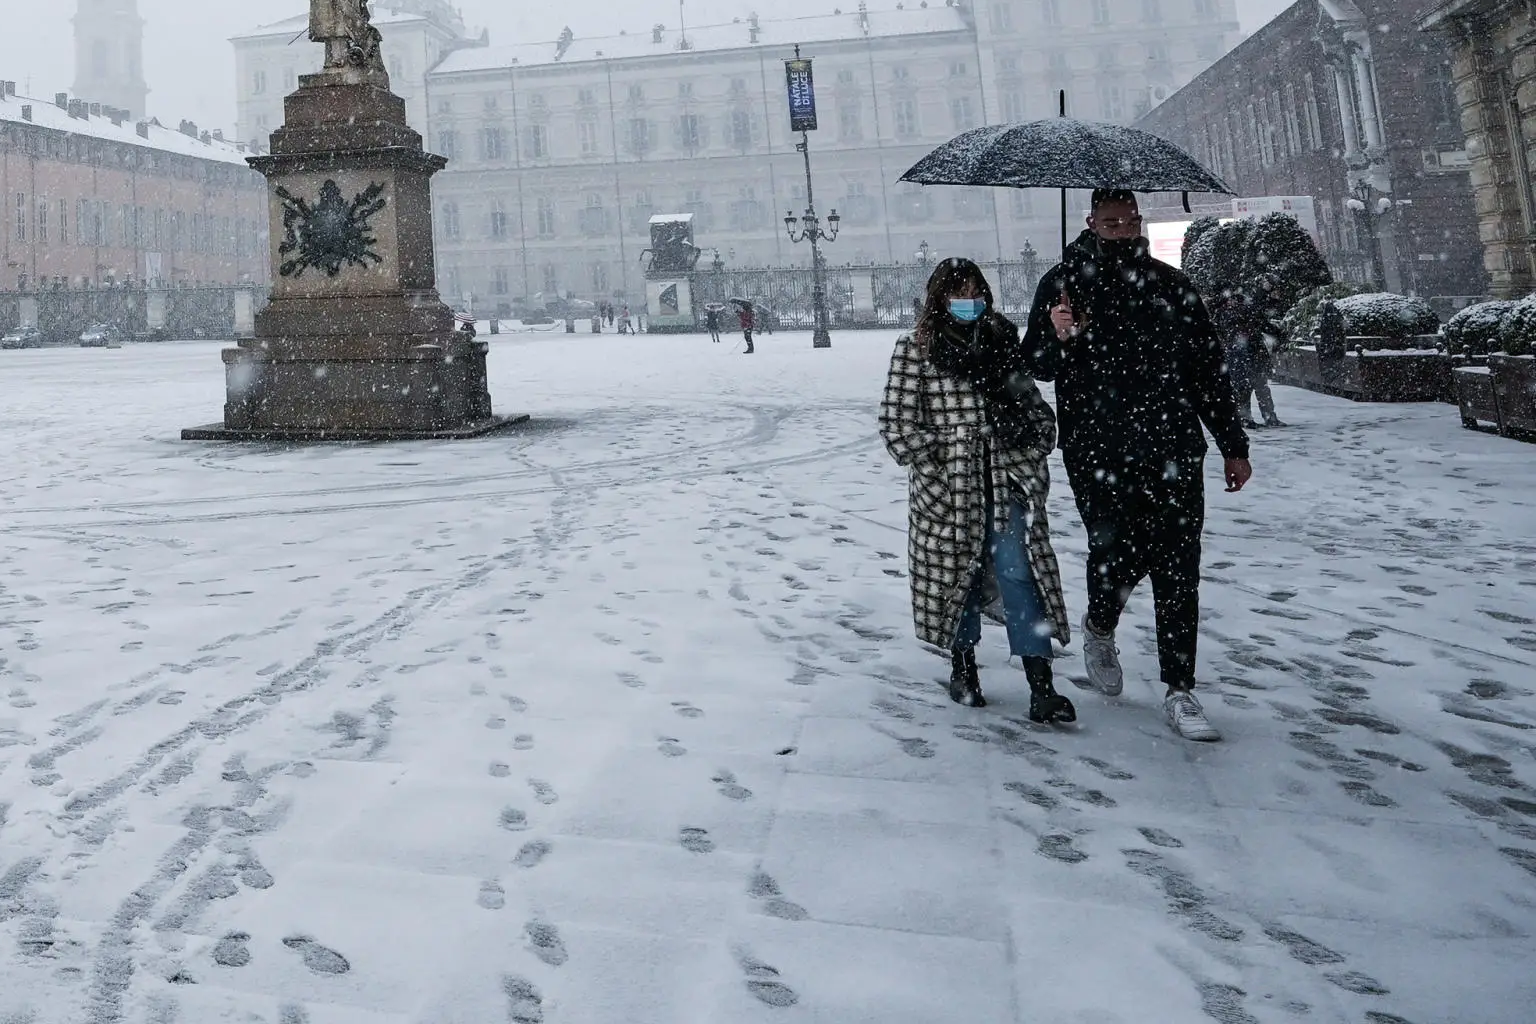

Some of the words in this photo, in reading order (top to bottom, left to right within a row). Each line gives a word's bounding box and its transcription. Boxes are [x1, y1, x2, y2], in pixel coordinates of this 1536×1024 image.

[791, 71, 802, 106] NATALE
[800, 71, 809, 94] LUCE
[802, 95, 810, 105] DI
